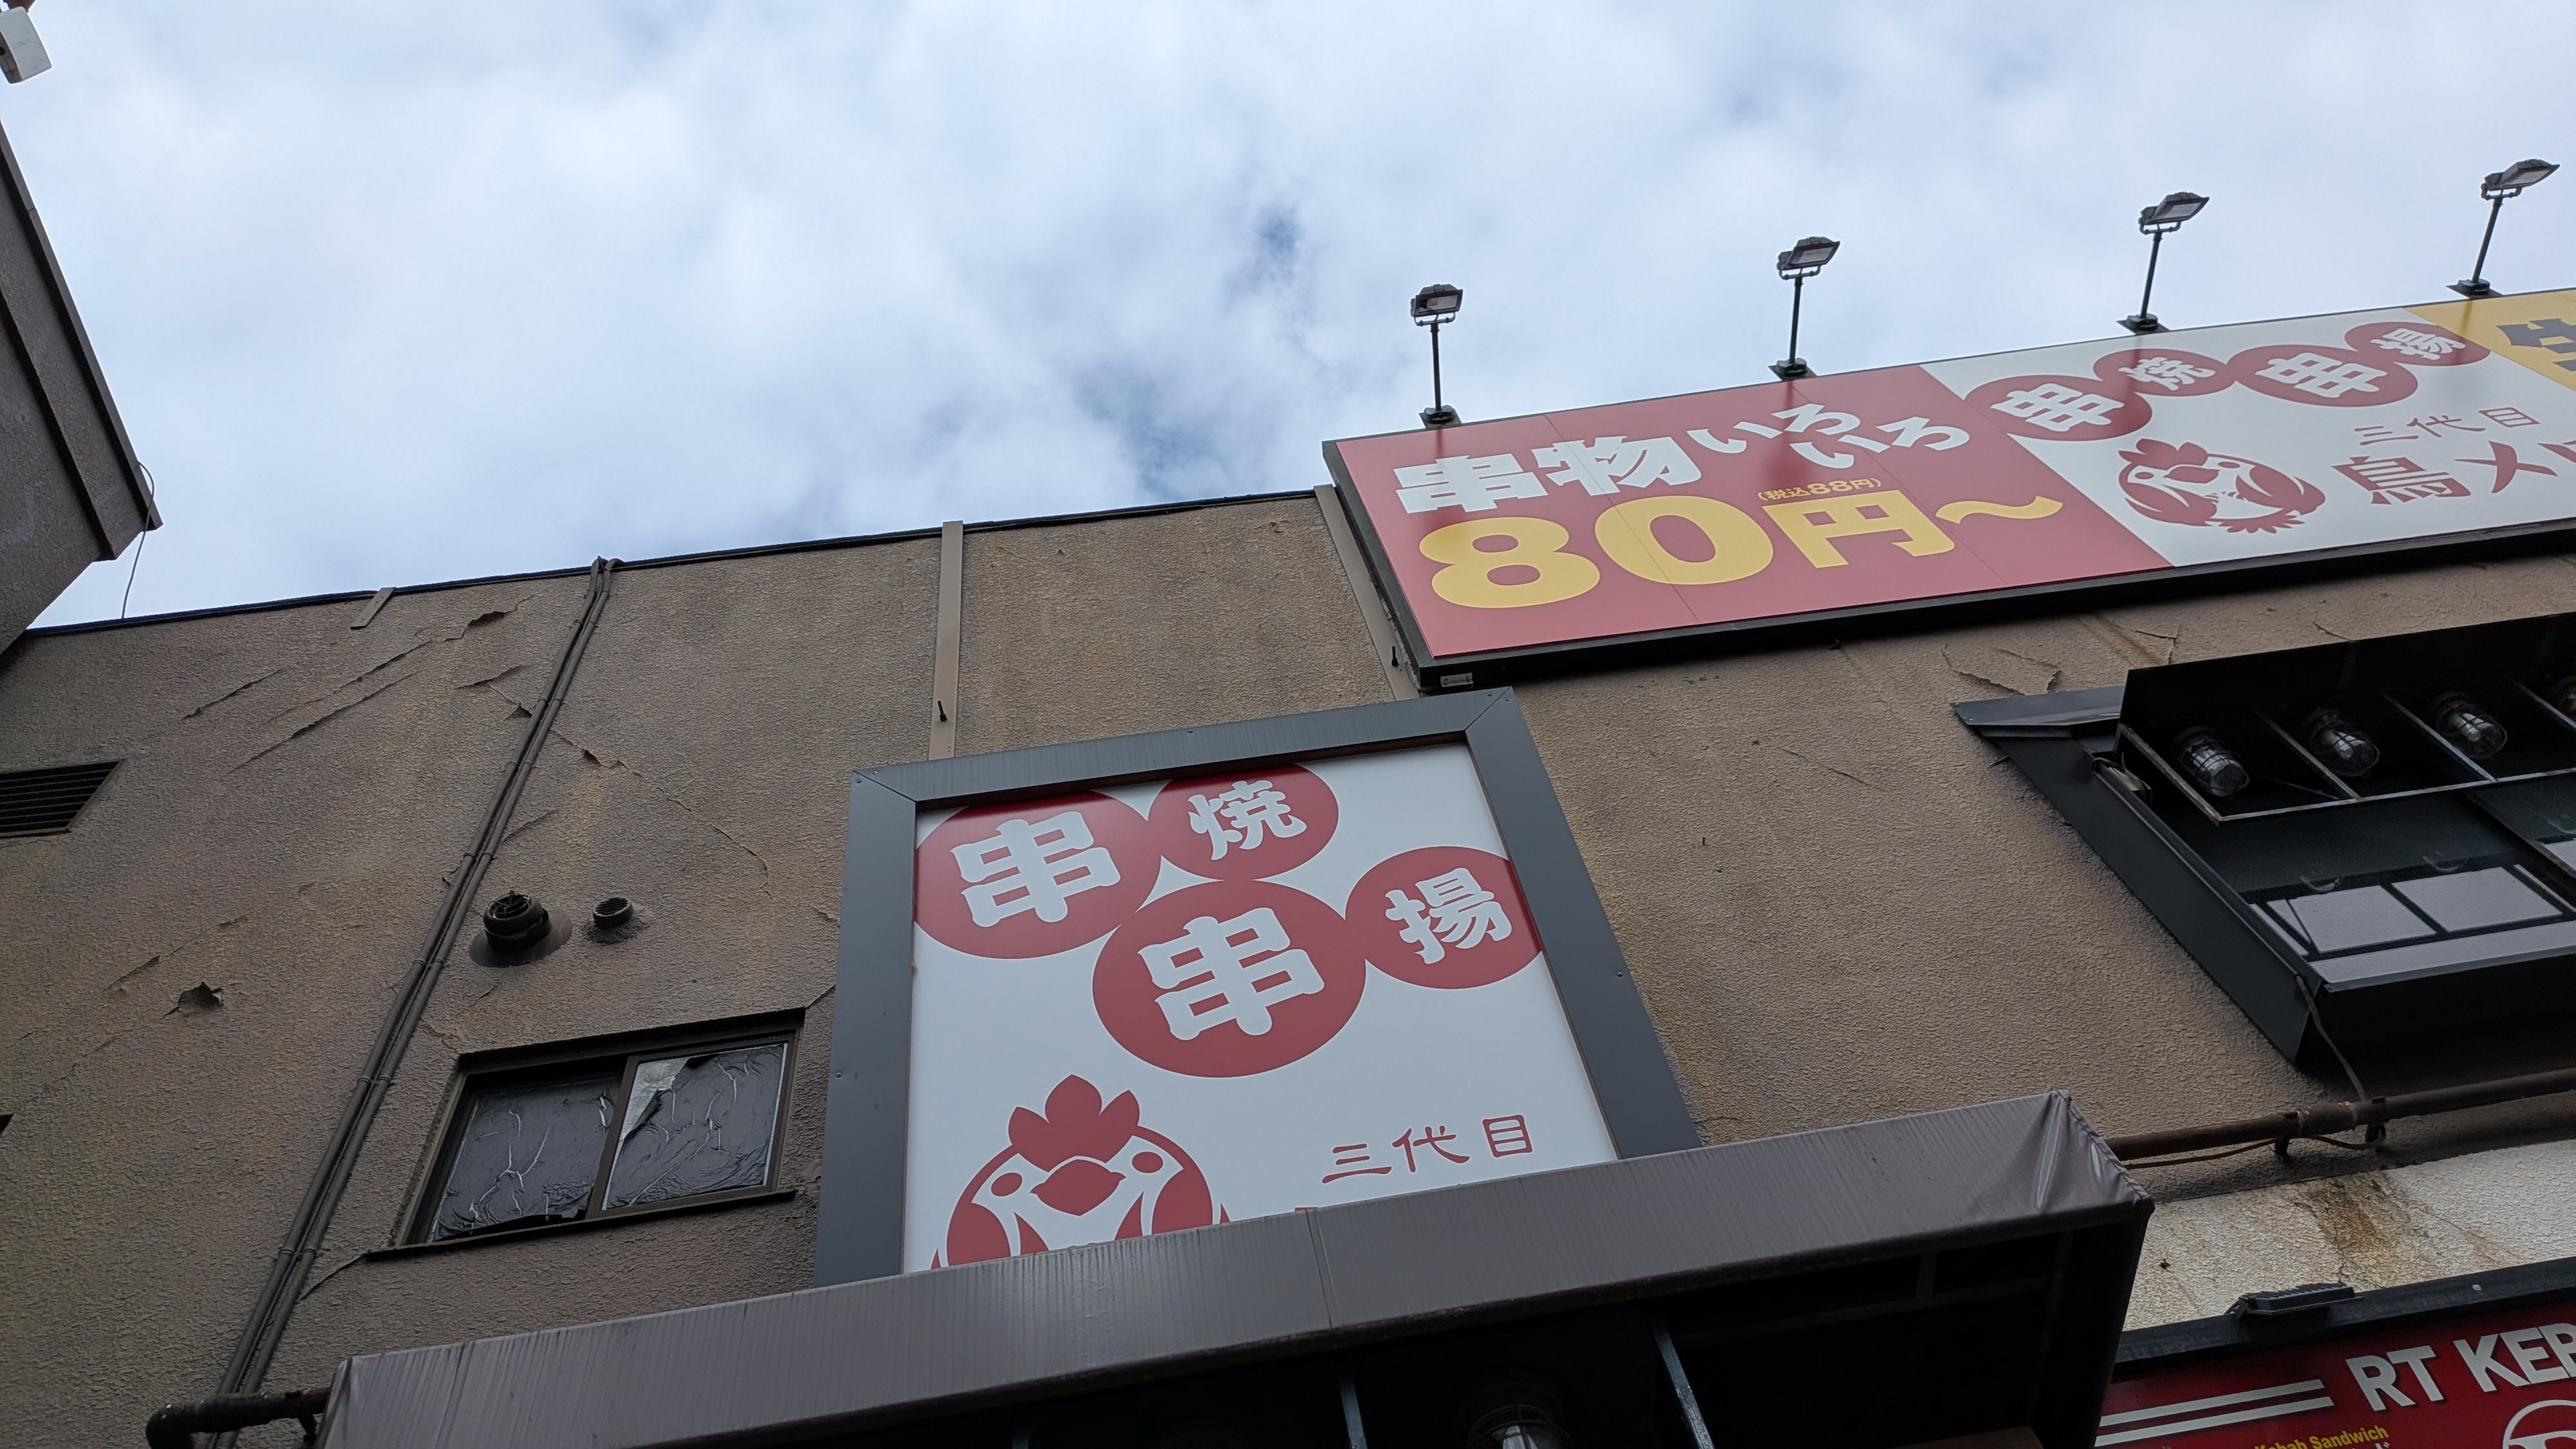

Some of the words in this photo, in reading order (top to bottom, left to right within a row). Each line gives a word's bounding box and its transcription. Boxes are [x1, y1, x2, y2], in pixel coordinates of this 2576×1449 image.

[2354, 407, 2540, 445] 三代目
[1758, 478, 1882, 501] (税込88円)
[2330, 440, 2576, 504] 鳥メ
[1322, 1114, 1532, 1184] 三代目
[2345, 1345, 2445, 1411] RT
[2309, 1425, 2389, 1449] Sandwich
